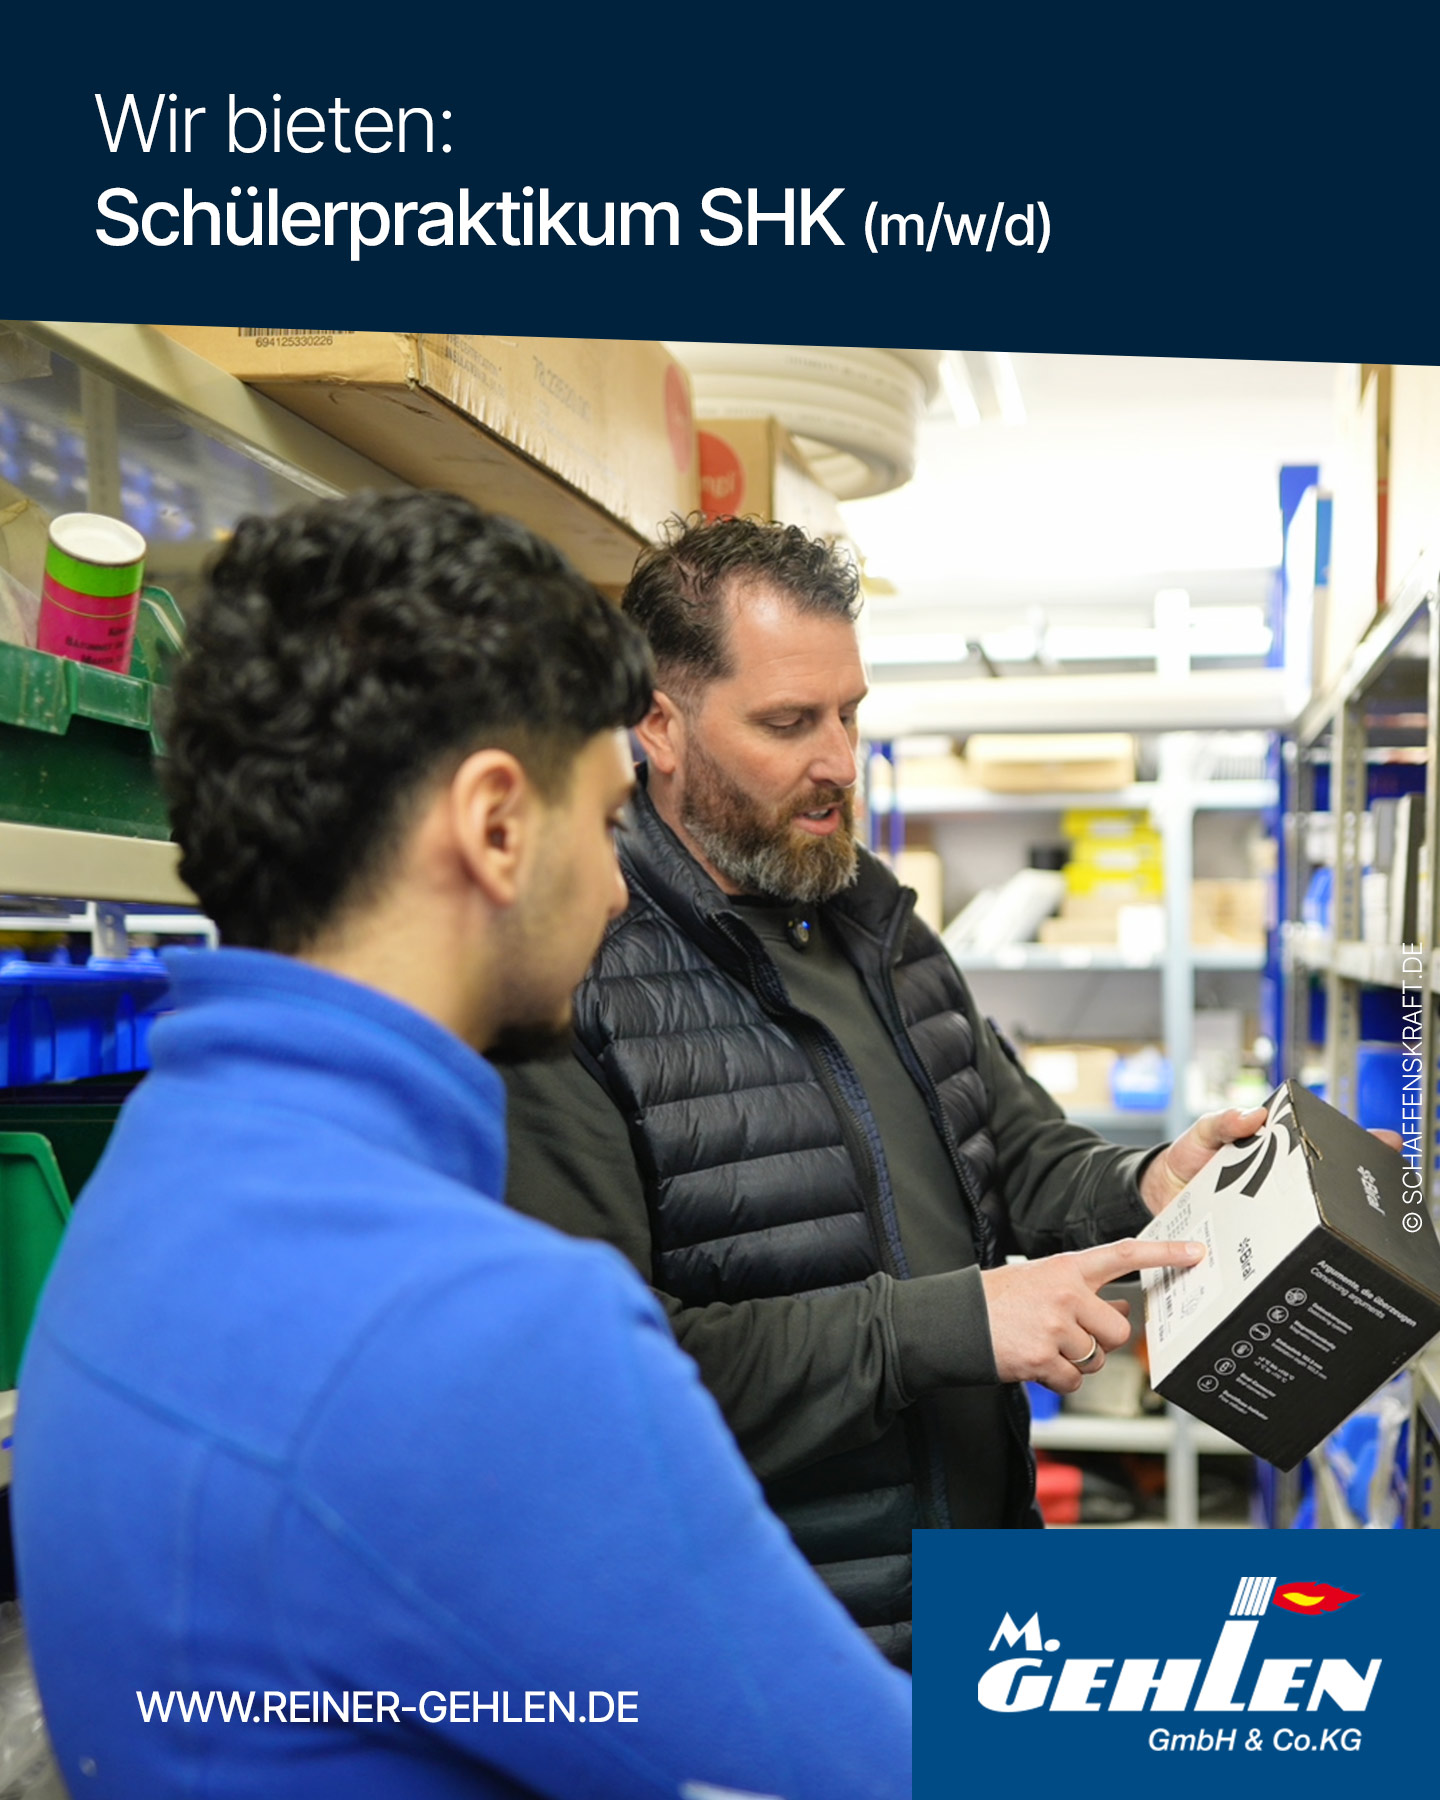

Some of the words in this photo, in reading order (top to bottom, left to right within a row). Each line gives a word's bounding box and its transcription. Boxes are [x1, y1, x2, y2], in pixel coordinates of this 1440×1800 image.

[1239, 1247, 1255, 1281] Biral
[1310, 1267, 1349, 1297] Convincing
[1348, 1293, 1385, 1319] arguments
[1361, 1288, 1374, 1299] die
[1373, 1295, 1417, 1327] überzeugen
